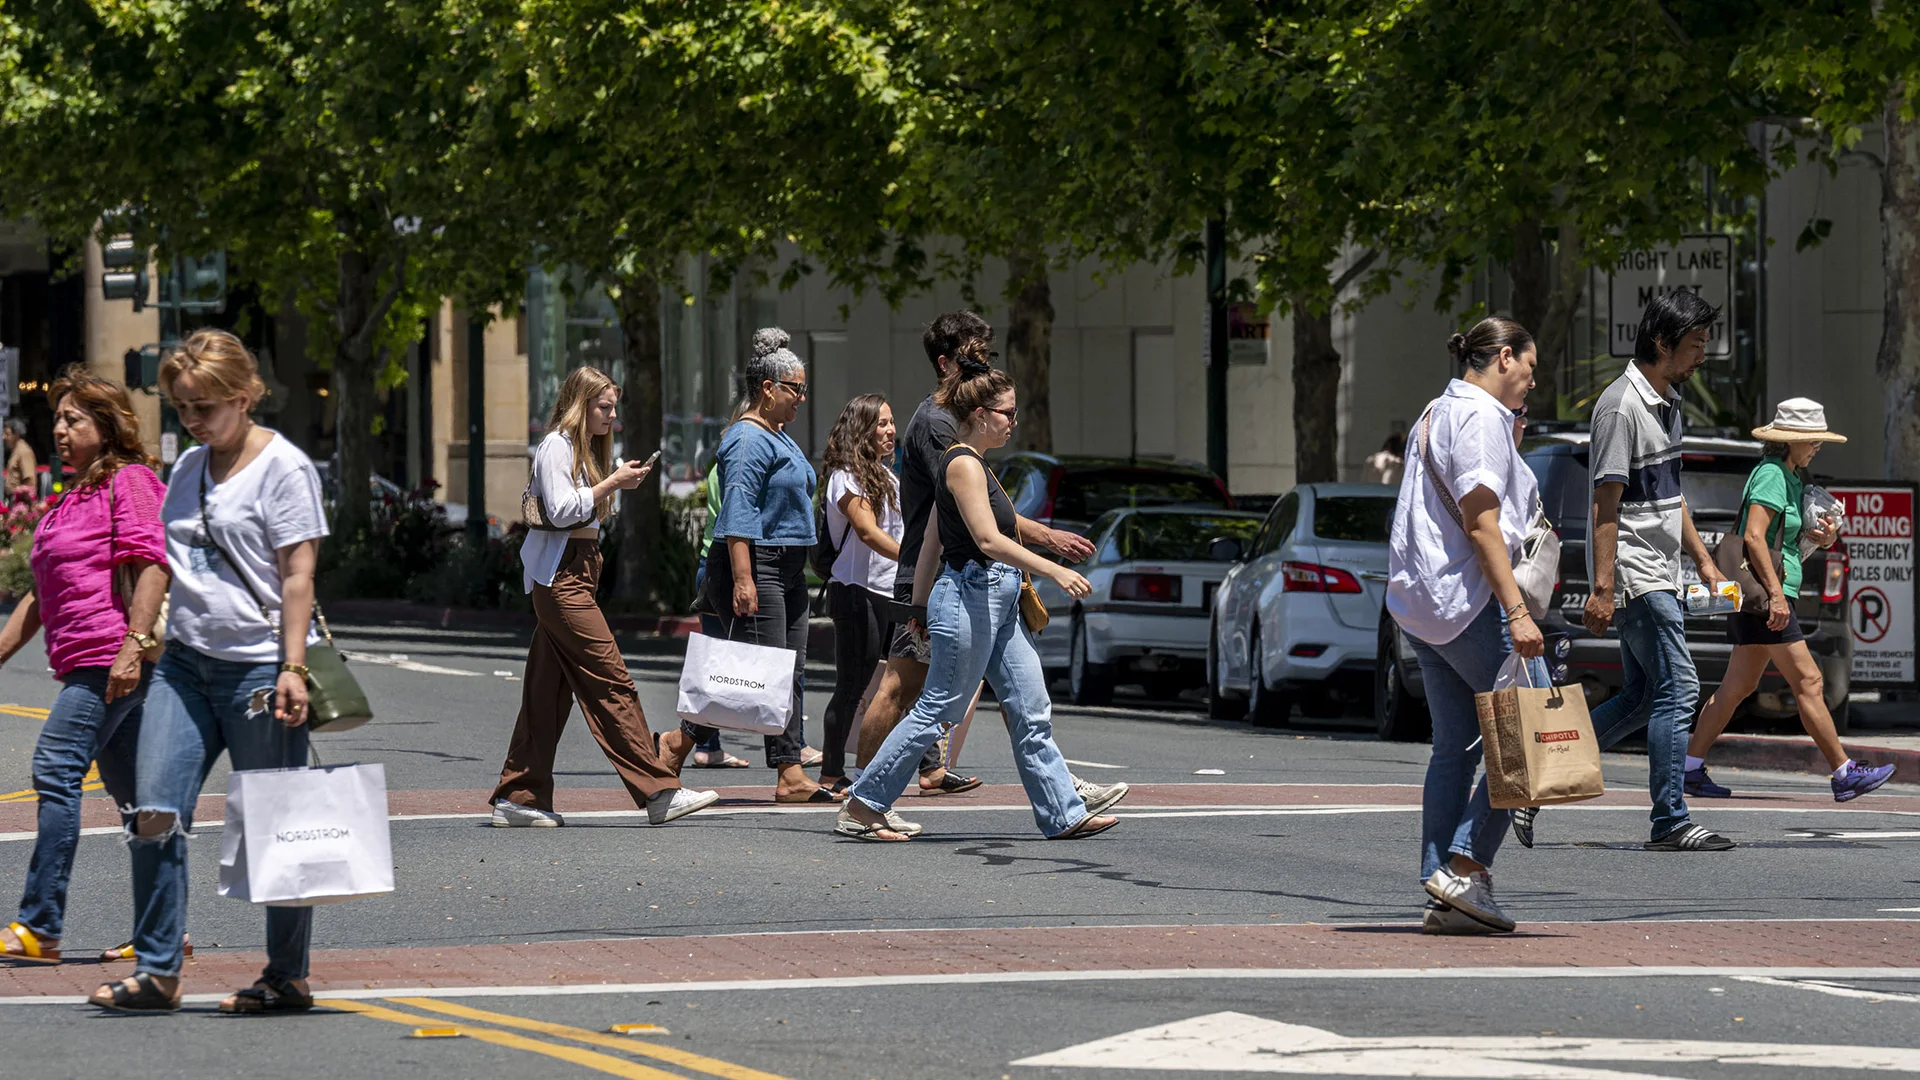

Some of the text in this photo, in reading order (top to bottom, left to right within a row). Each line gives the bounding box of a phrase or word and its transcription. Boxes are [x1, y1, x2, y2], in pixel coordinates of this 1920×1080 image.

[1617, 250, 1723, 271] RIGHT LANE
[1638, 284, 1702, 308] MT
[1856, 493, 1884, 514] NO
[1840, 514, 1911, 536] ARKING
[1847, 542, 1910, 560] ERGENCY
[1848, 566, 1914, 581] ICLES ONLY
[709, 674, 766, 690] NORDSTROM
[1542, 731, 1578, 742] CHIPOTLE
[275, 827, 350, 843] NORDSTROM
